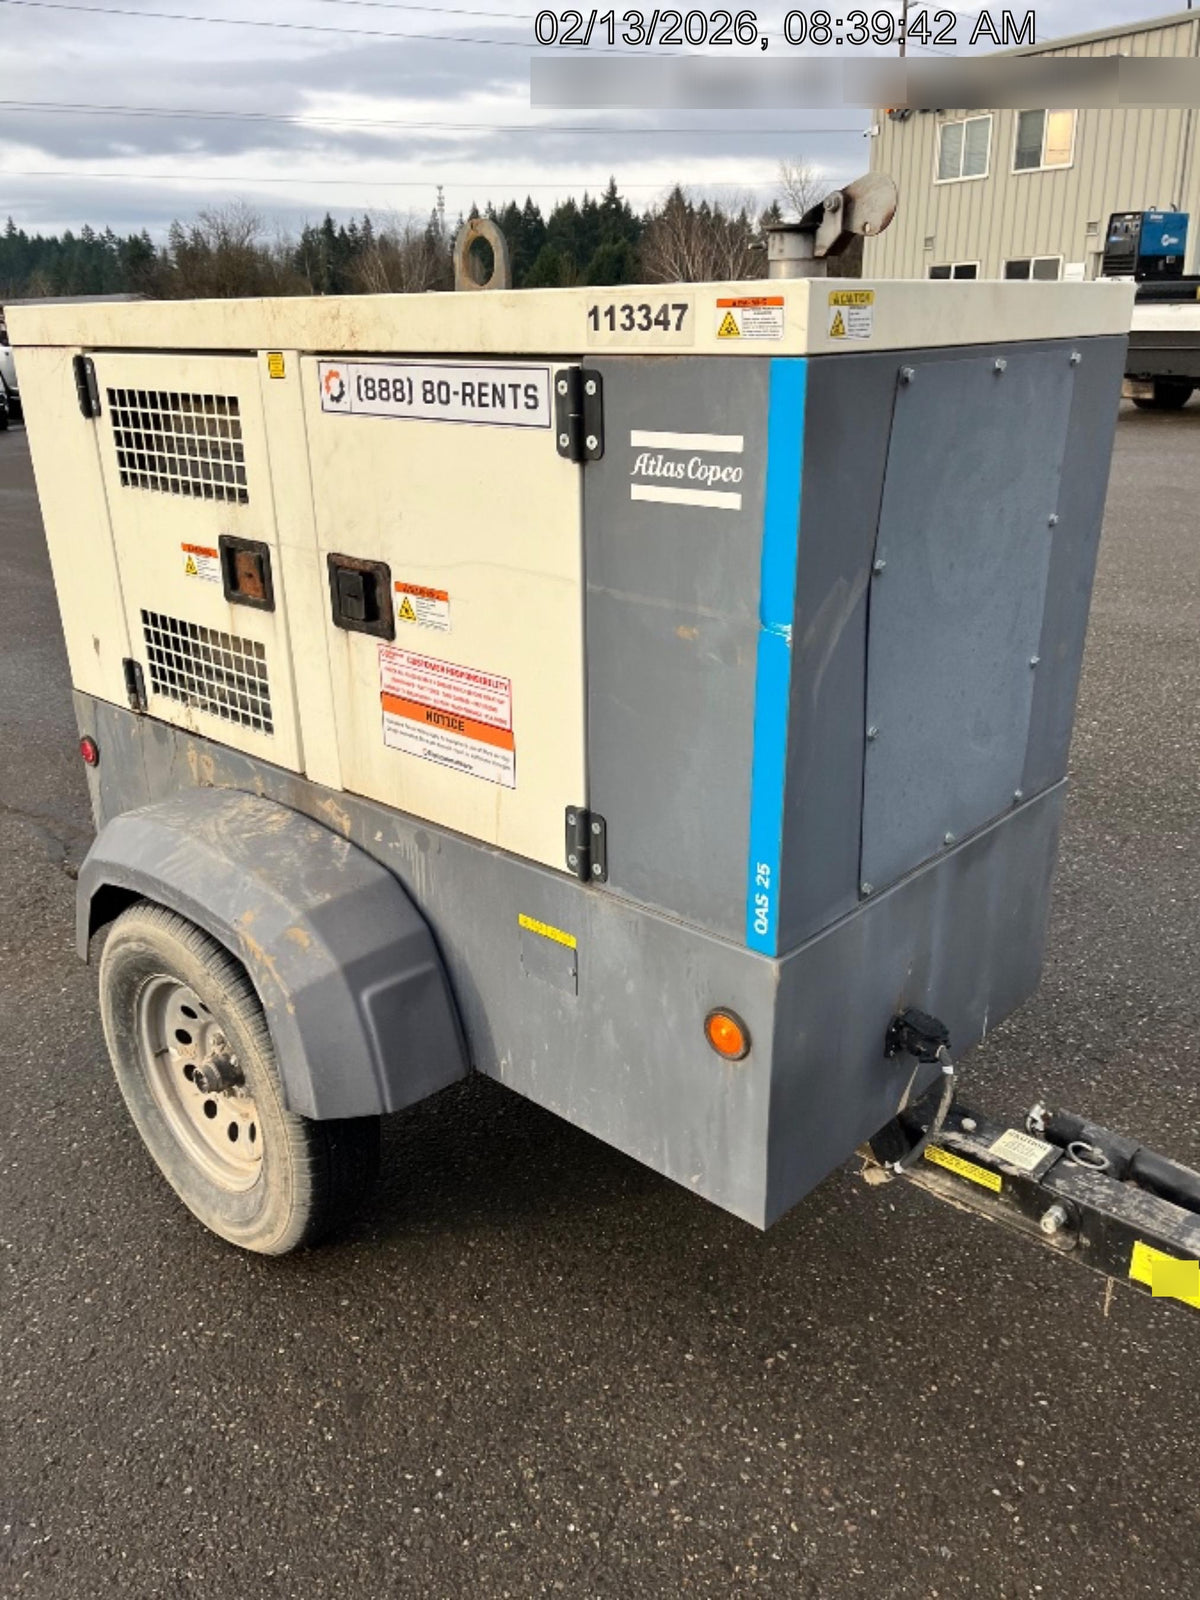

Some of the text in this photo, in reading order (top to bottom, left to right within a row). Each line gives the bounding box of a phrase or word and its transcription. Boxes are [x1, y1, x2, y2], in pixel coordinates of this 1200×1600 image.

[587, 303, 689, 332] 113347
[356, 374, 539, 410] (888) 80-RENTS
[630, 452, 743, 486] Atlas Copco
[425, 710, 465, 732] NOTICE
[755, 862, 771, 889] 25
